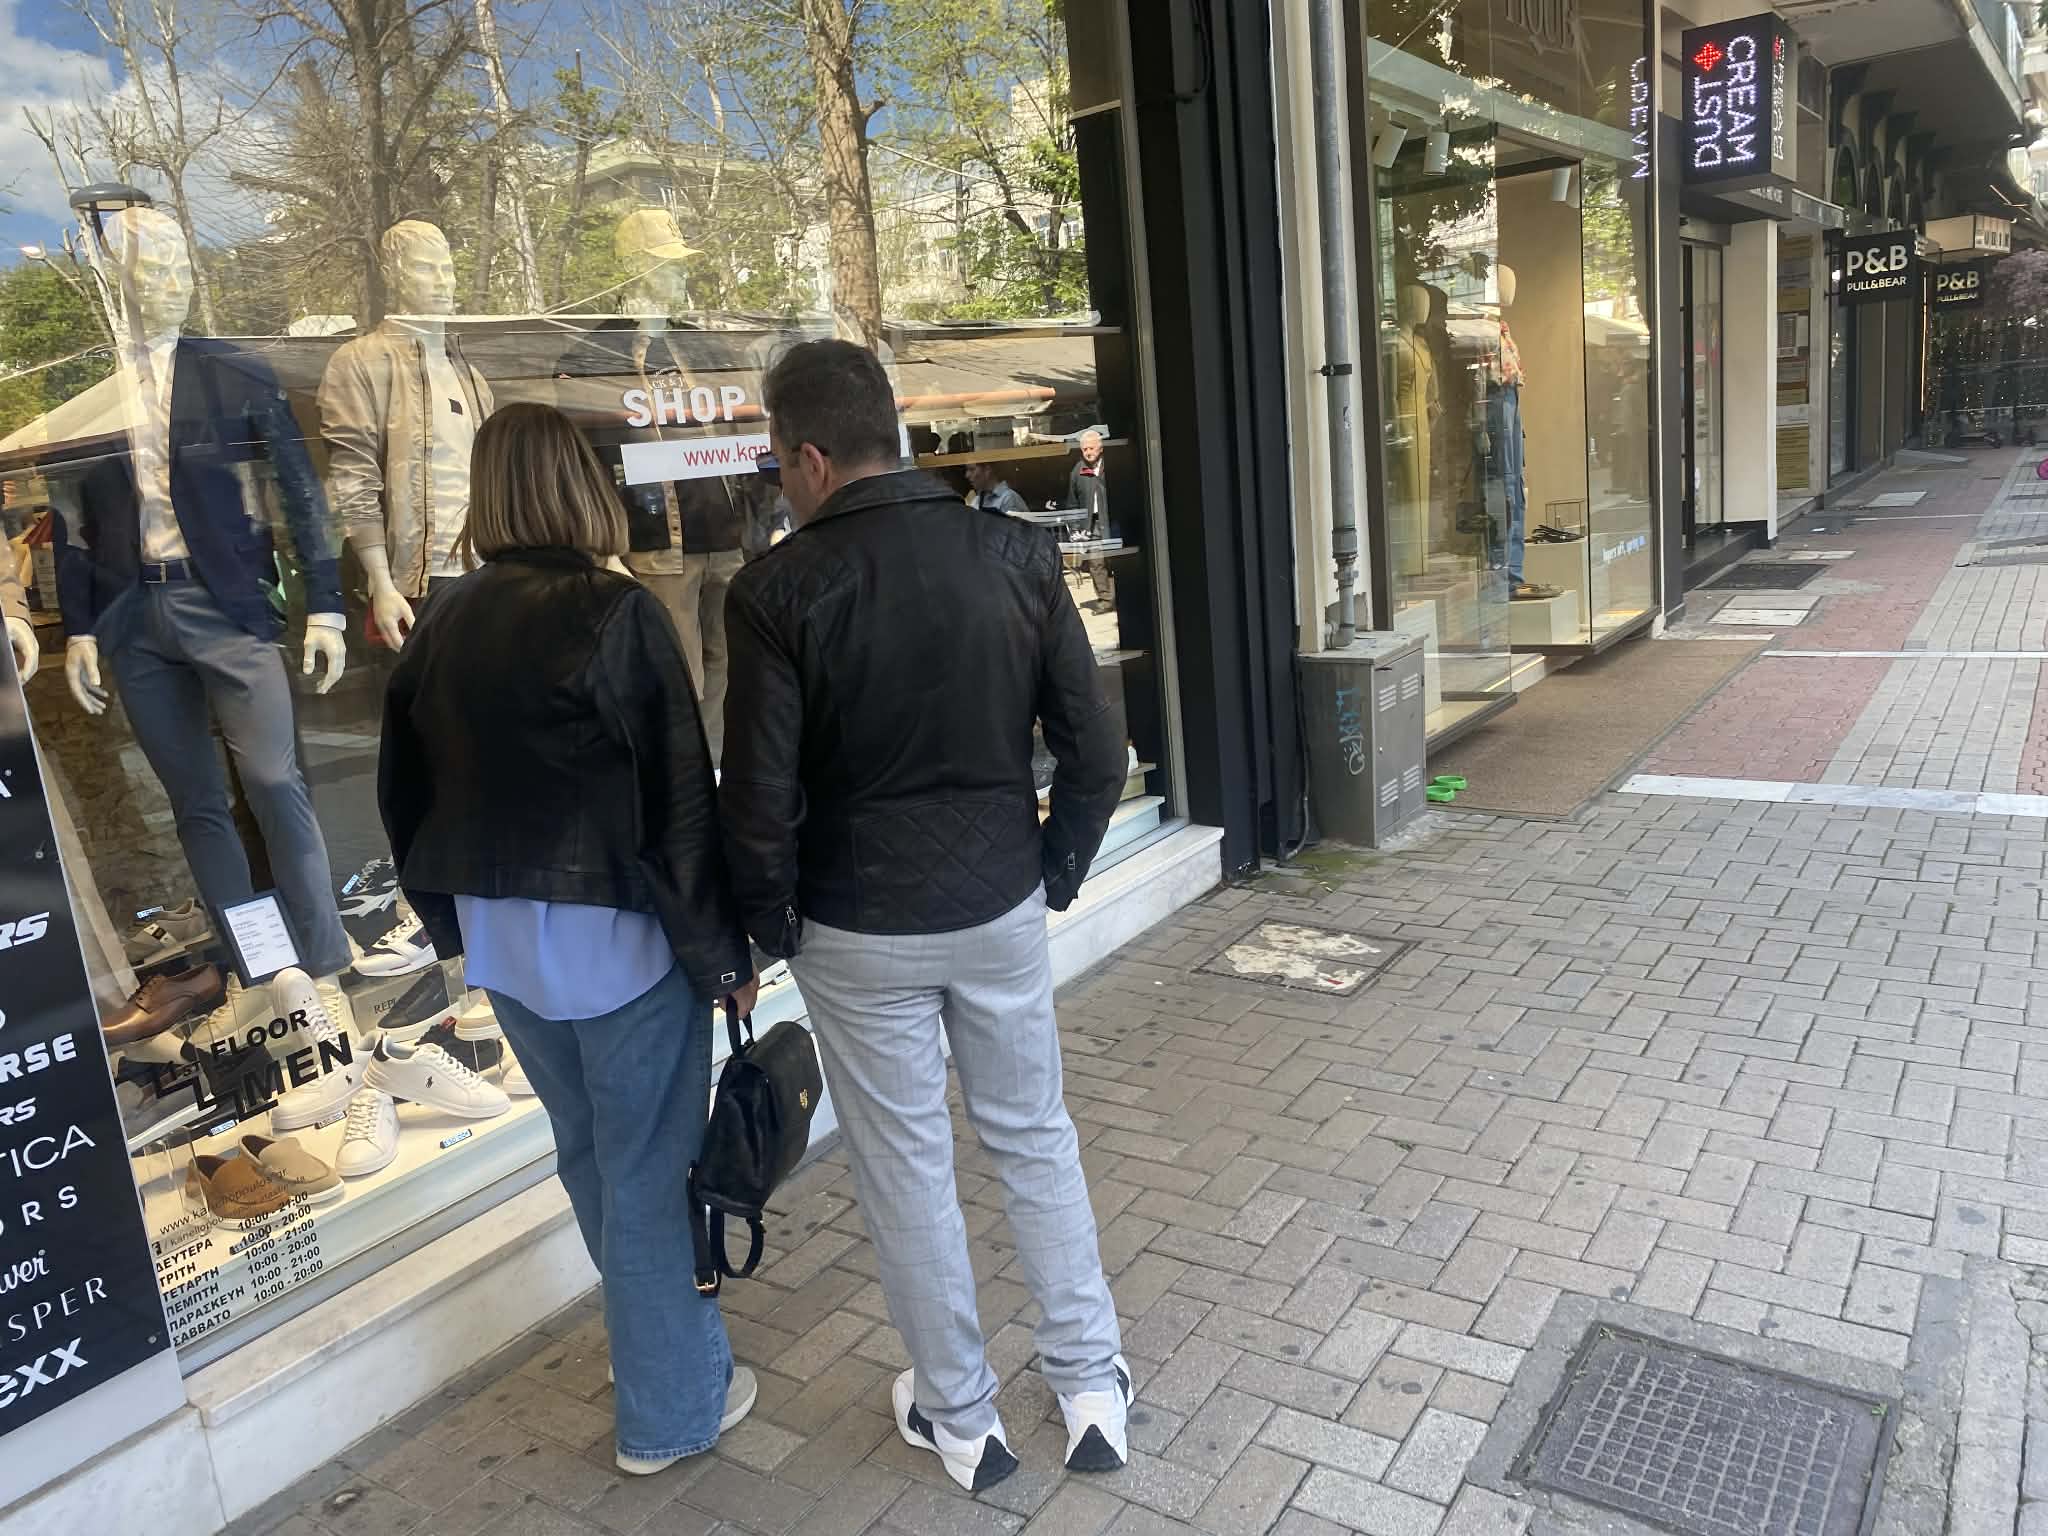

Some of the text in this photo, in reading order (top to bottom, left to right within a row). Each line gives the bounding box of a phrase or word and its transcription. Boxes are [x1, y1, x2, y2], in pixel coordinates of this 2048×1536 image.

[1693, 76, 1722, 168] DUST
[1727, 35, 1756, 163] CREAM
[1846, 245, 1909, 276] P&B
[1847, 276, 1907, 292] PULL&BEAR
[1937, 270, 1980, 292] P&B
[623, 386, 746, 427] SHOP
[210, 1009, 310, 1062] FLOOR
[242, 1031, 354, 1109] MEN
[0, 1125, 96, 1177] ICA
[0, 1186, 78, 1237] RS
[156, 1238, 213, 1272] ΔΕΥΤΕΡΑ
[238, 1211, 269, 1232] 10:00
[162, 1266, 220, 1302] ΤΕΤΑΡΤΗ
[244, 1238, 275, 1260] 10:00
[286, 1218, 315, 1240] 21:00
[166, 1283, 219, 1318] ΠΕΜΠΤΗ
[248, 1252, 278, 1275] 10:00
[289, 1232, 318, 1254] 20:00
[169, 1285, 245, 1332] ΠΑΡΑΣΚΕΥΗ
[251, 1266, 281, 1289] 10:00
[291, 1246, 320, 1269] 21:00
[7, 1278, 108, 1342] SPER
[173, 1309, 231, 1347] ΣΑΒΒΑΤΟ
[254, 1280, 284, 1303] 10:00
[294, 1260, 323, 1282] 20:00
